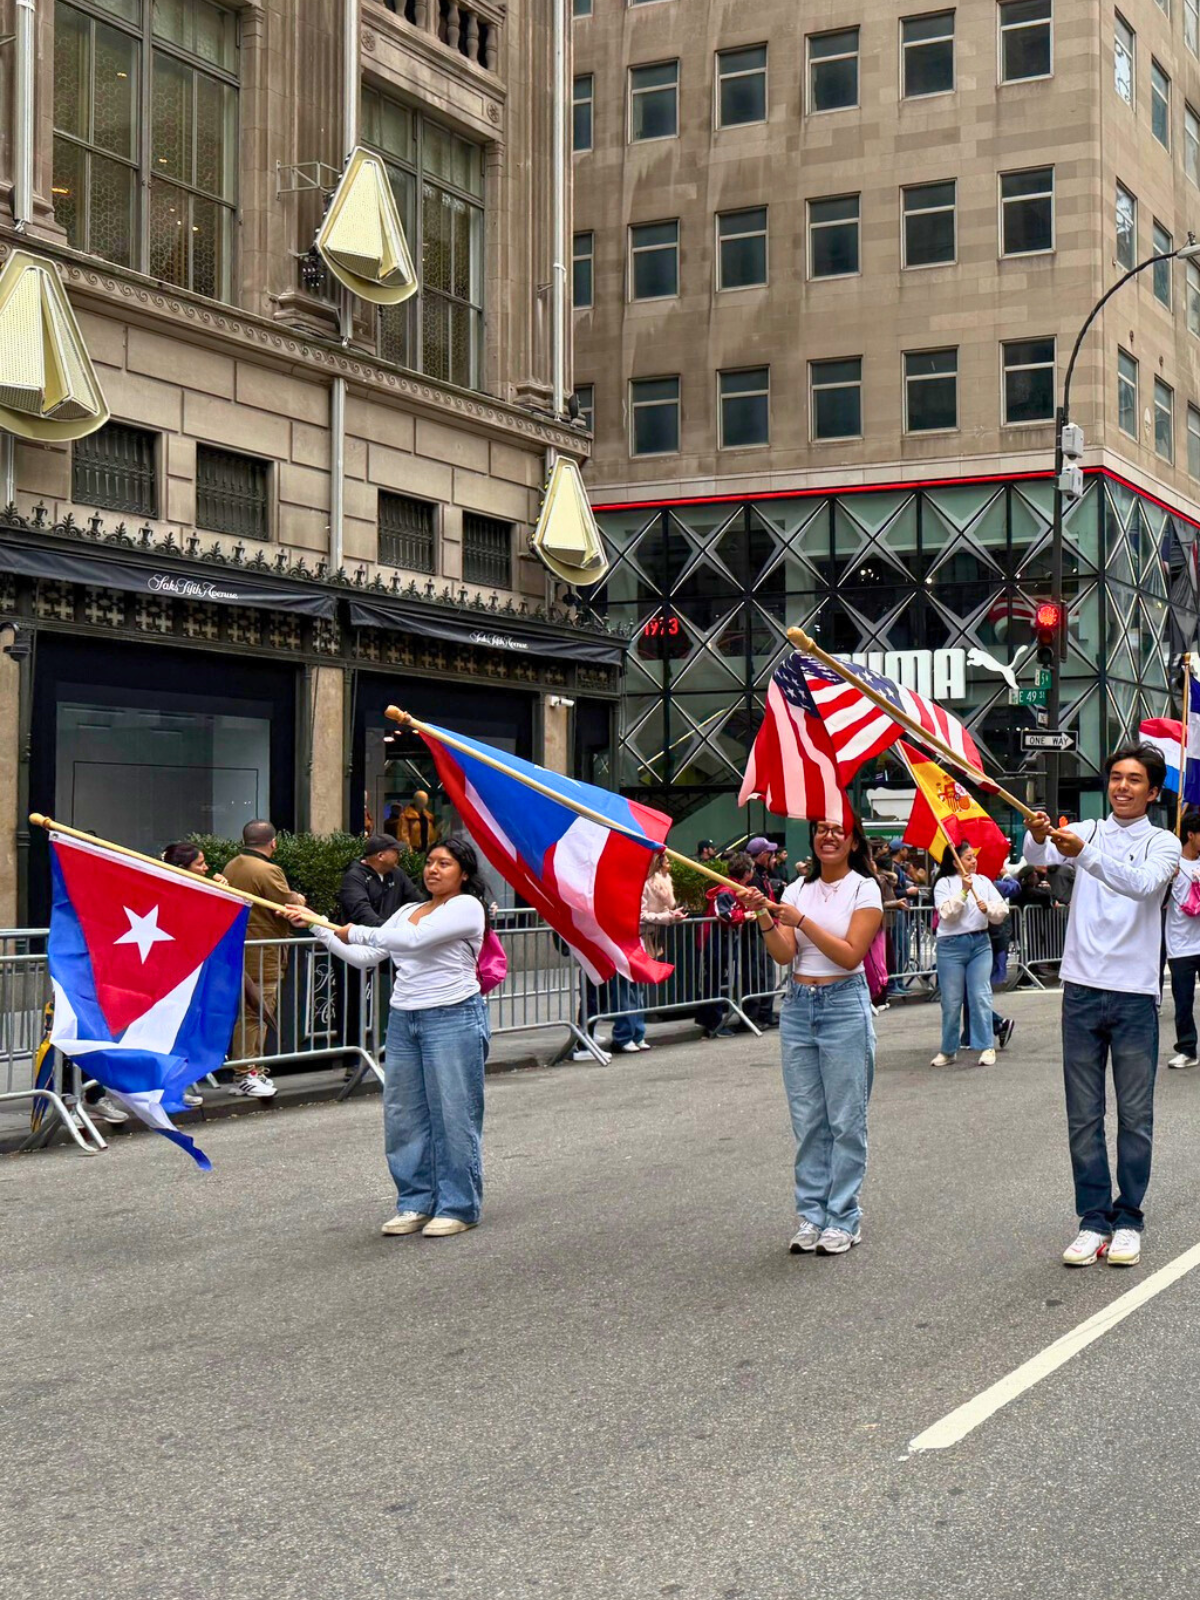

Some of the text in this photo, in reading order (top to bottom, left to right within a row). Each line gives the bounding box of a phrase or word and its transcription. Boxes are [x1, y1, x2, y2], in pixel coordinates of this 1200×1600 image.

[148, 573, 239, 600] Saks Fifth Avenue
[830, 649, 966, 700] MA
[1019, 691, 1023, 703] E
[1026, 690, 1037, 702] 49
[1029, 736, 1069, 746] ONE WAY
